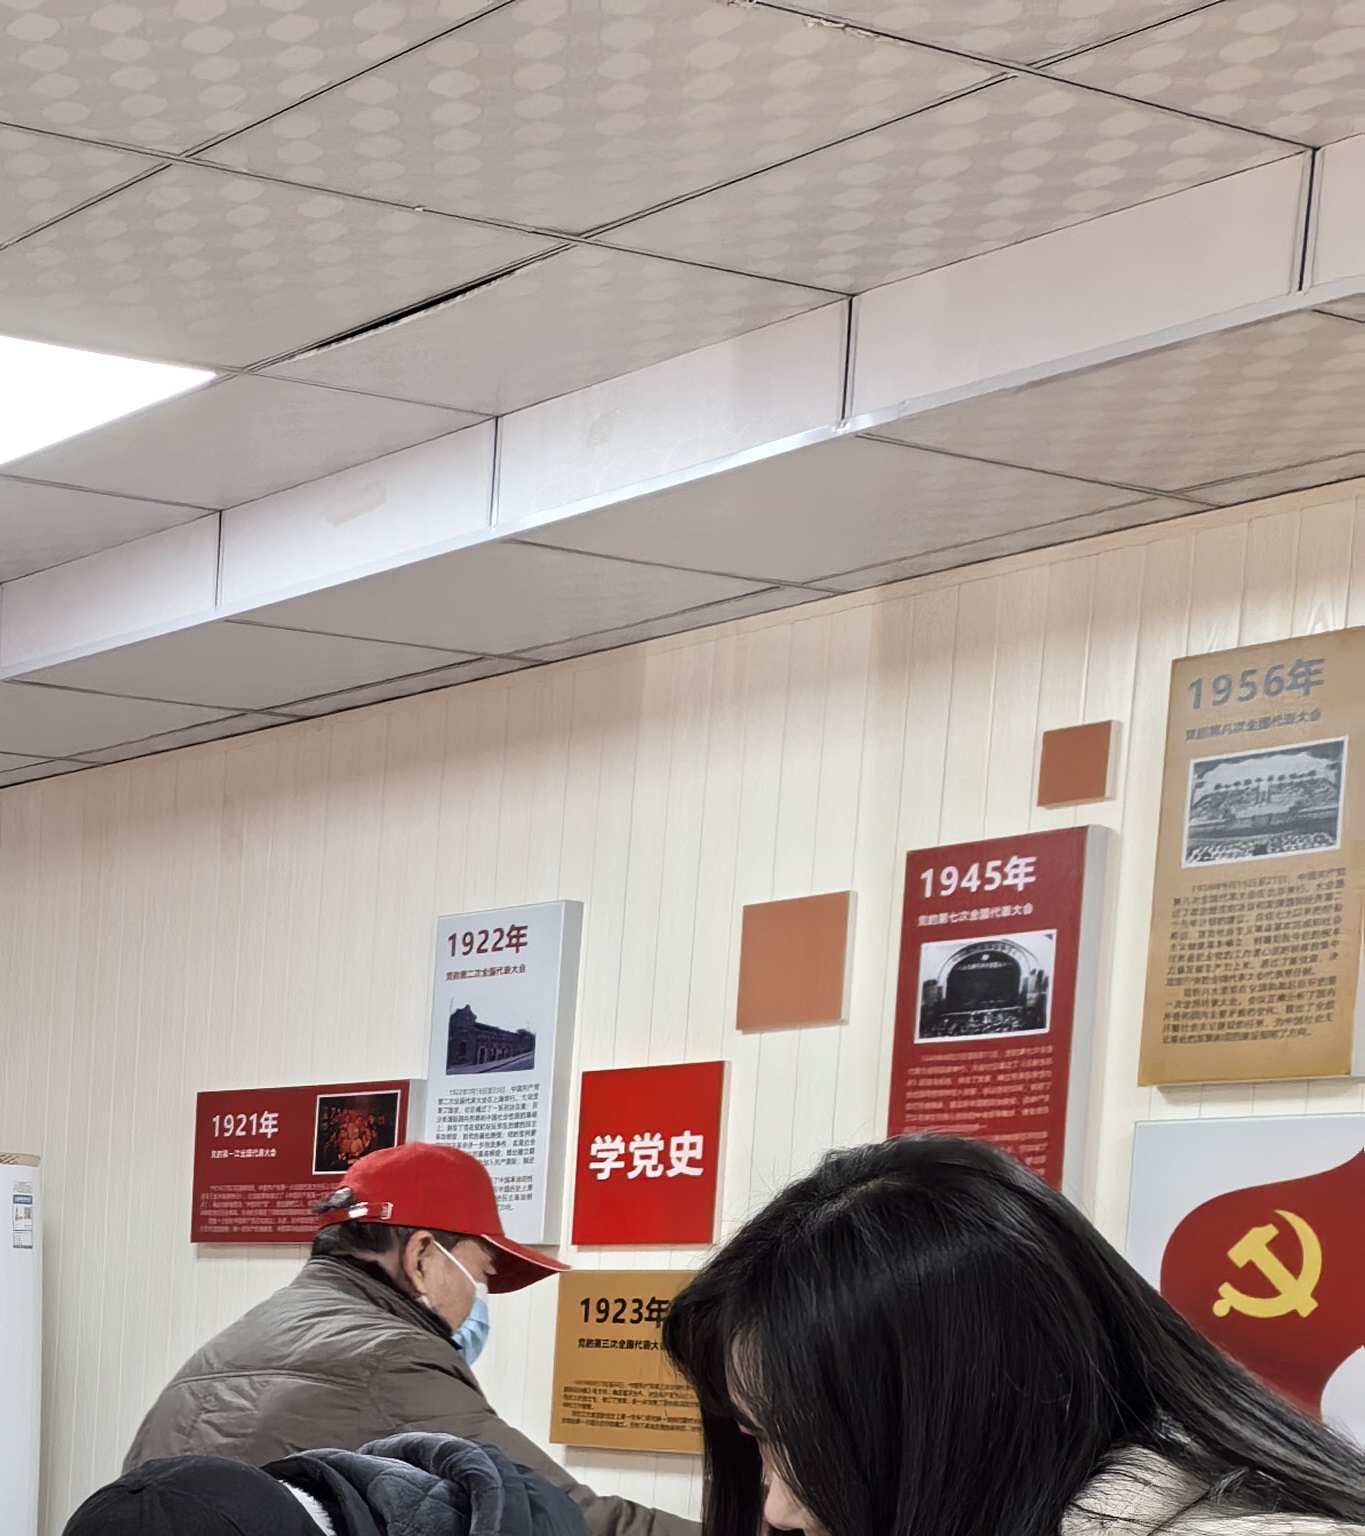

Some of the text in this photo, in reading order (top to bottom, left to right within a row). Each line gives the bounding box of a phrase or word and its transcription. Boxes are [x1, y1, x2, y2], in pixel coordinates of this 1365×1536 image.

[1188, 658, 1325, 710] 1956年
[920, 855, 1037, 899] 1945年
[448, 924, 529, 957] 1922年
[212, 1110, 279, 1139] 1921年
[589, 1129, 704, 1181] 学党史
[579, 1296, 671, 1326] 1923年
[577, 1338, 668, 1351] 党的第三次全国代表大
